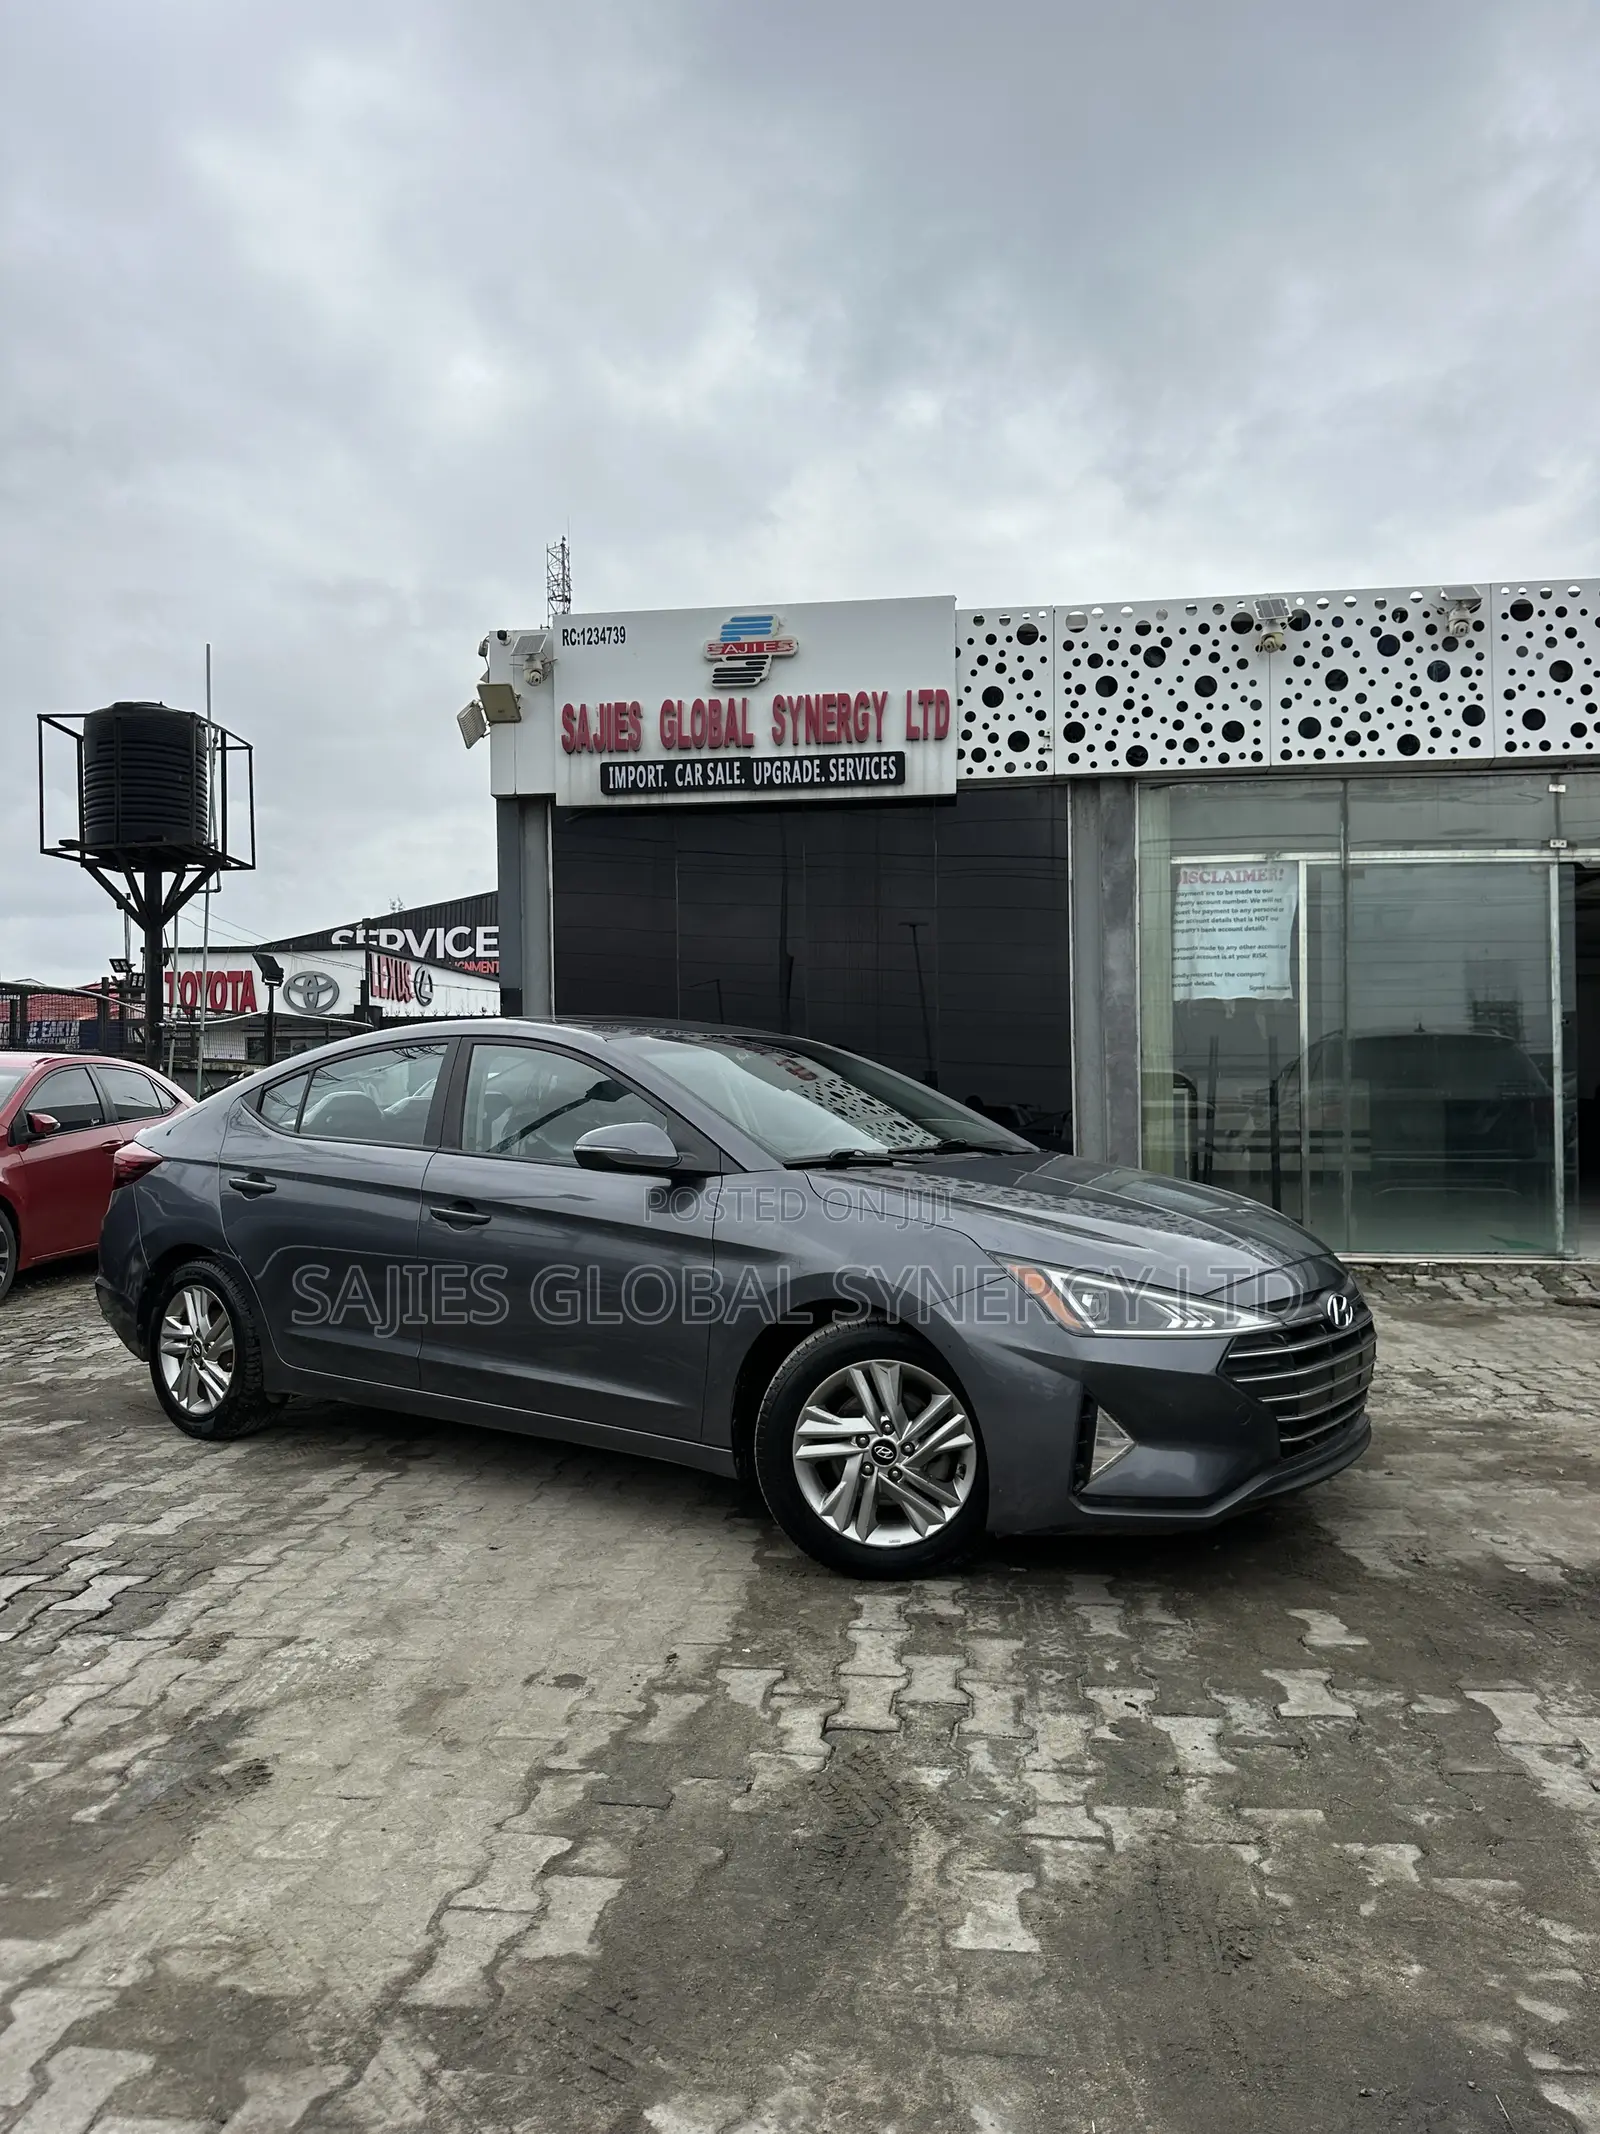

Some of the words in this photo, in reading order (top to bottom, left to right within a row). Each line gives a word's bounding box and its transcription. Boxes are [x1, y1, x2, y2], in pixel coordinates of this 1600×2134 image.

[562, 625, 626, 646] RC:1234739
[707, 639, 796, 655] SAJIES
[561, 701, 643, 754] SAJIES
[659, 697, 755, 749] GLOBAL
[771, 690, 889, 746] SYNERGY
[905, 688, 951, 741] LTD
[608, 764, 668, 789] IMPORT.
[674, 762, 704, 787] CAR
[706, 761, 746, 785] SALE.
[752, 758, 826, 785] UPGRADE.
[829, 755, 897, 782] SERVICES
[1202, 908, 1230, 916] payment
[164, 970, 258, 1016] TOYOTA
[369, 951, 412, 1004] LEXUS
